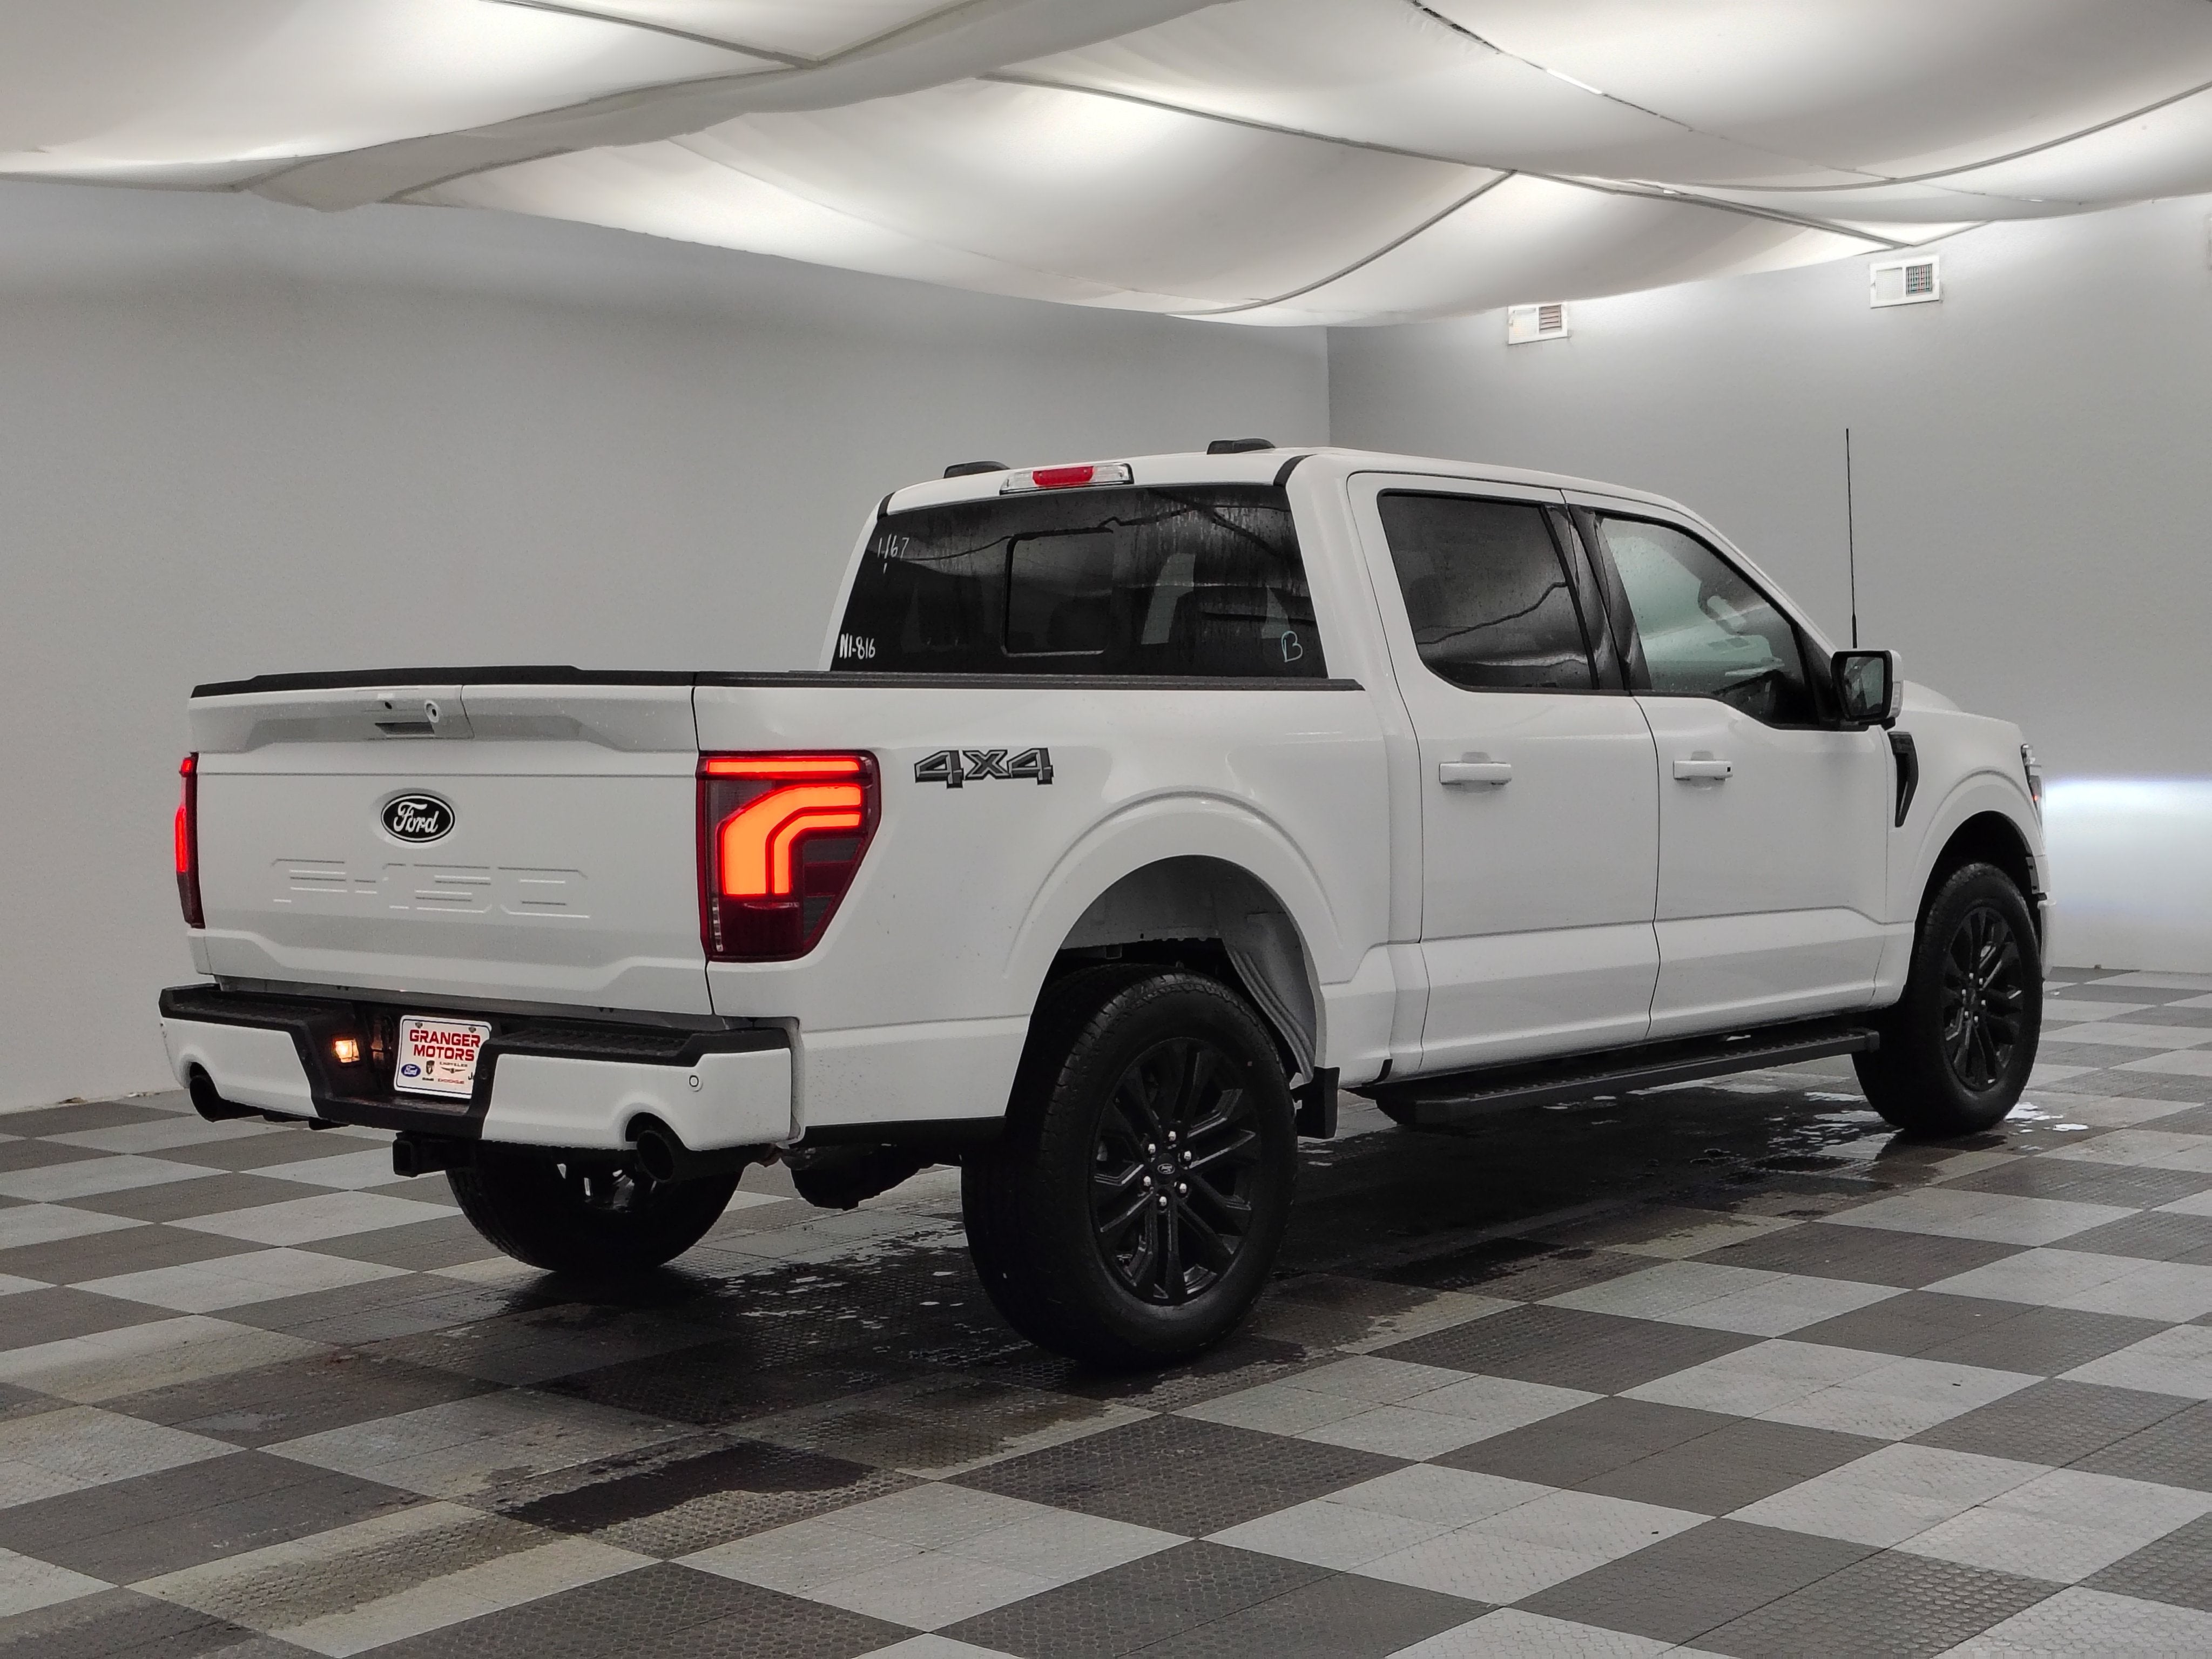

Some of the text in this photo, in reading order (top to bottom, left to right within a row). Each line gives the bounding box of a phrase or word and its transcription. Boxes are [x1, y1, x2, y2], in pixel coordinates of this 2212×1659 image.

[394, 801, 439, 833] Ford
[409, 1029, 481, 1048] GRANGER
[414, 1044, 475, 1061] MOTORS
